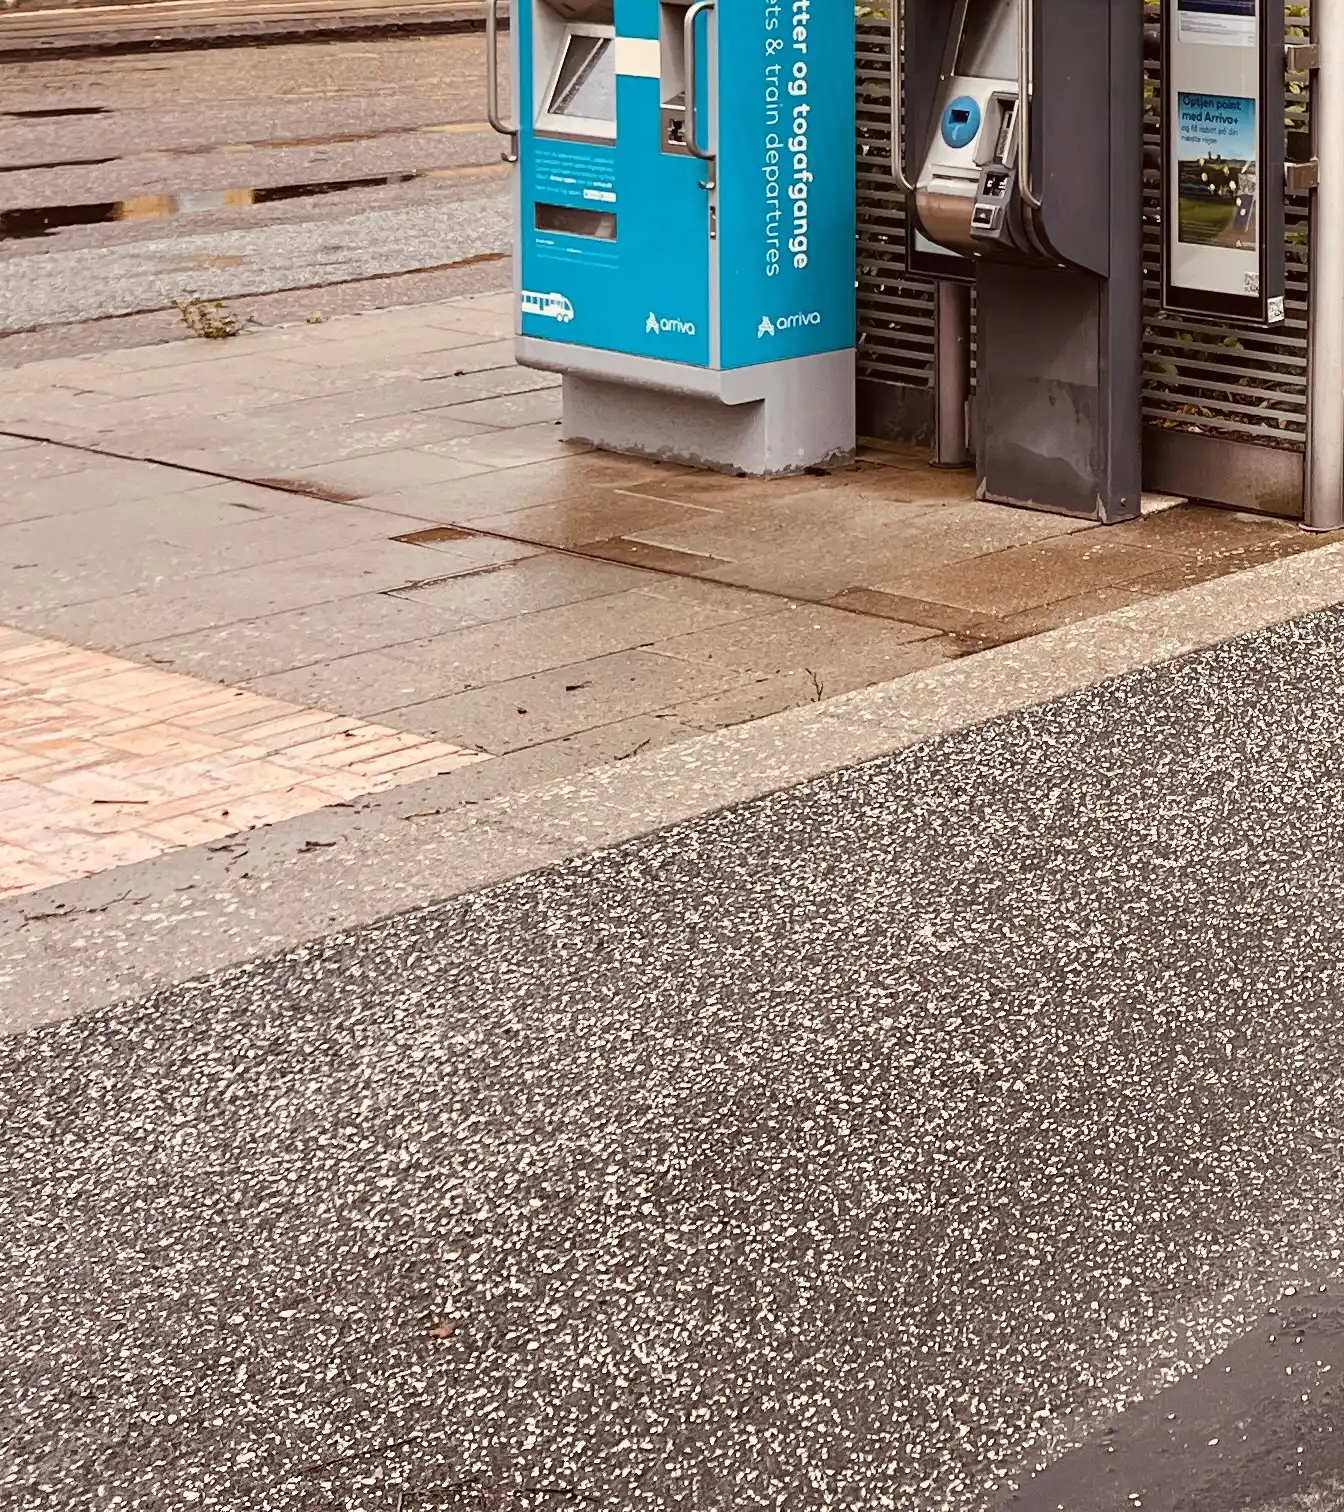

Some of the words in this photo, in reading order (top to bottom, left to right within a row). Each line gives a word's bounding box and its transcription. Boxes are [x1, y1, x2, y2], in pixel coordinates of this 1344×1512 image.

[765, 38, 784, 57] &
[787, 61, 807, 96] og
[765, 63, 784, 125] train
[1183, 95, 1215, 109] Optjen
[1216, 100, 1242, 111] point
[1182, 112, 1203, 122] med
[1204, 112, 1239, 125] Arriva+
[787, 104, 814, 269] togafgange
[761, 133, 785, 277] departures
[660, 318, 696, 336] arriva
[776, 310, 821, 330] arriva
